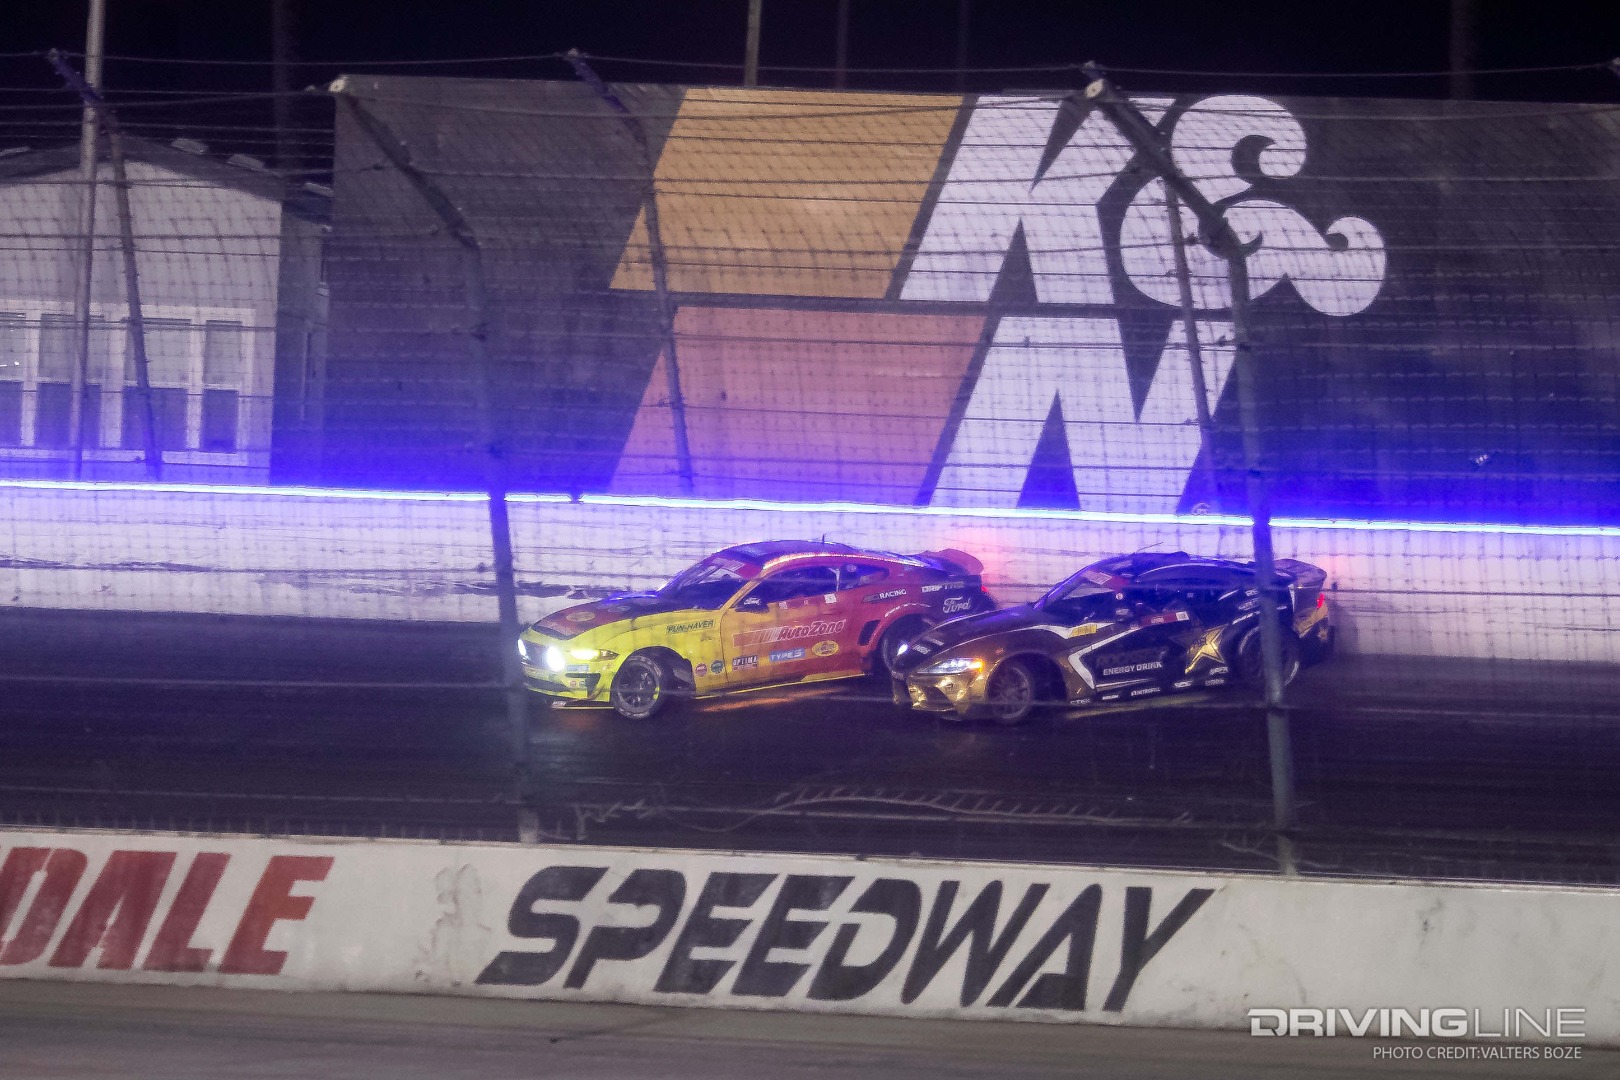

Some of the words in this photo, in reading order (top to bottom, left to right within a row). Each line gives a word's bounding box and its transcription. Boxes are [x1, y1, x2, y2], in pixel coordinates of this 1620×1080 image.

[879, 588, 907, 599] RACING
[942, 596, 972, 614] Ford
[777, 619, 846, 641] AutoZone
[1103, 665, 1135, 676] ENERGY
[1136, 661, 1163, 671] DRINK
[474, 865, 1215, 1012] SPEEDWAY
